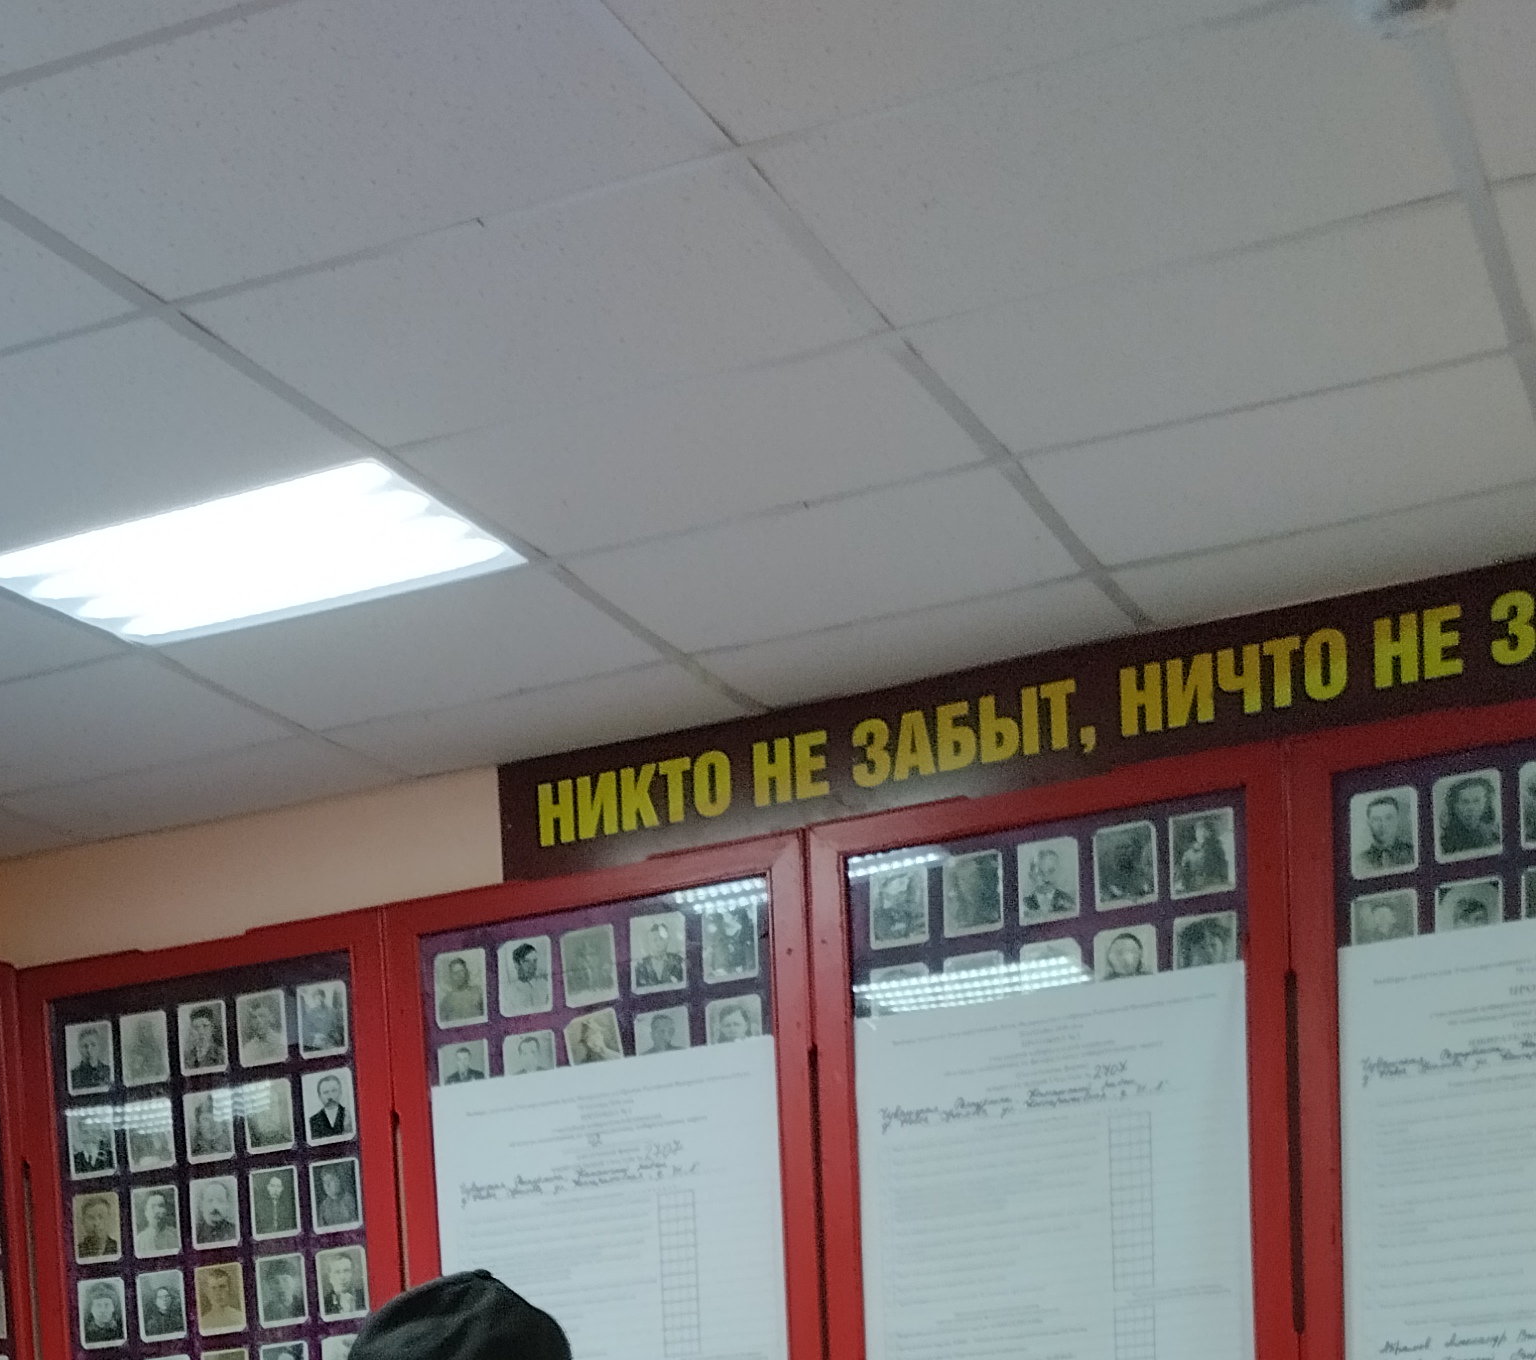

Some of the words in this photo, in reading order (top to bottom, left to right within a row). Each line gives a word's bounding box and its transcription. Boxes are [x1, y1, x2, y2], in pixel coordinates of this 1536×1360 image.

[537, 756, 732, 847] НИКТО
[752, 729, 829, 807] НЕ
[852, 679, 1096, 787] ЗАБЫТ,
[1120, 628, 1348, 736] НИЧТО
[1373, 604, 1463, 689] НЕ
